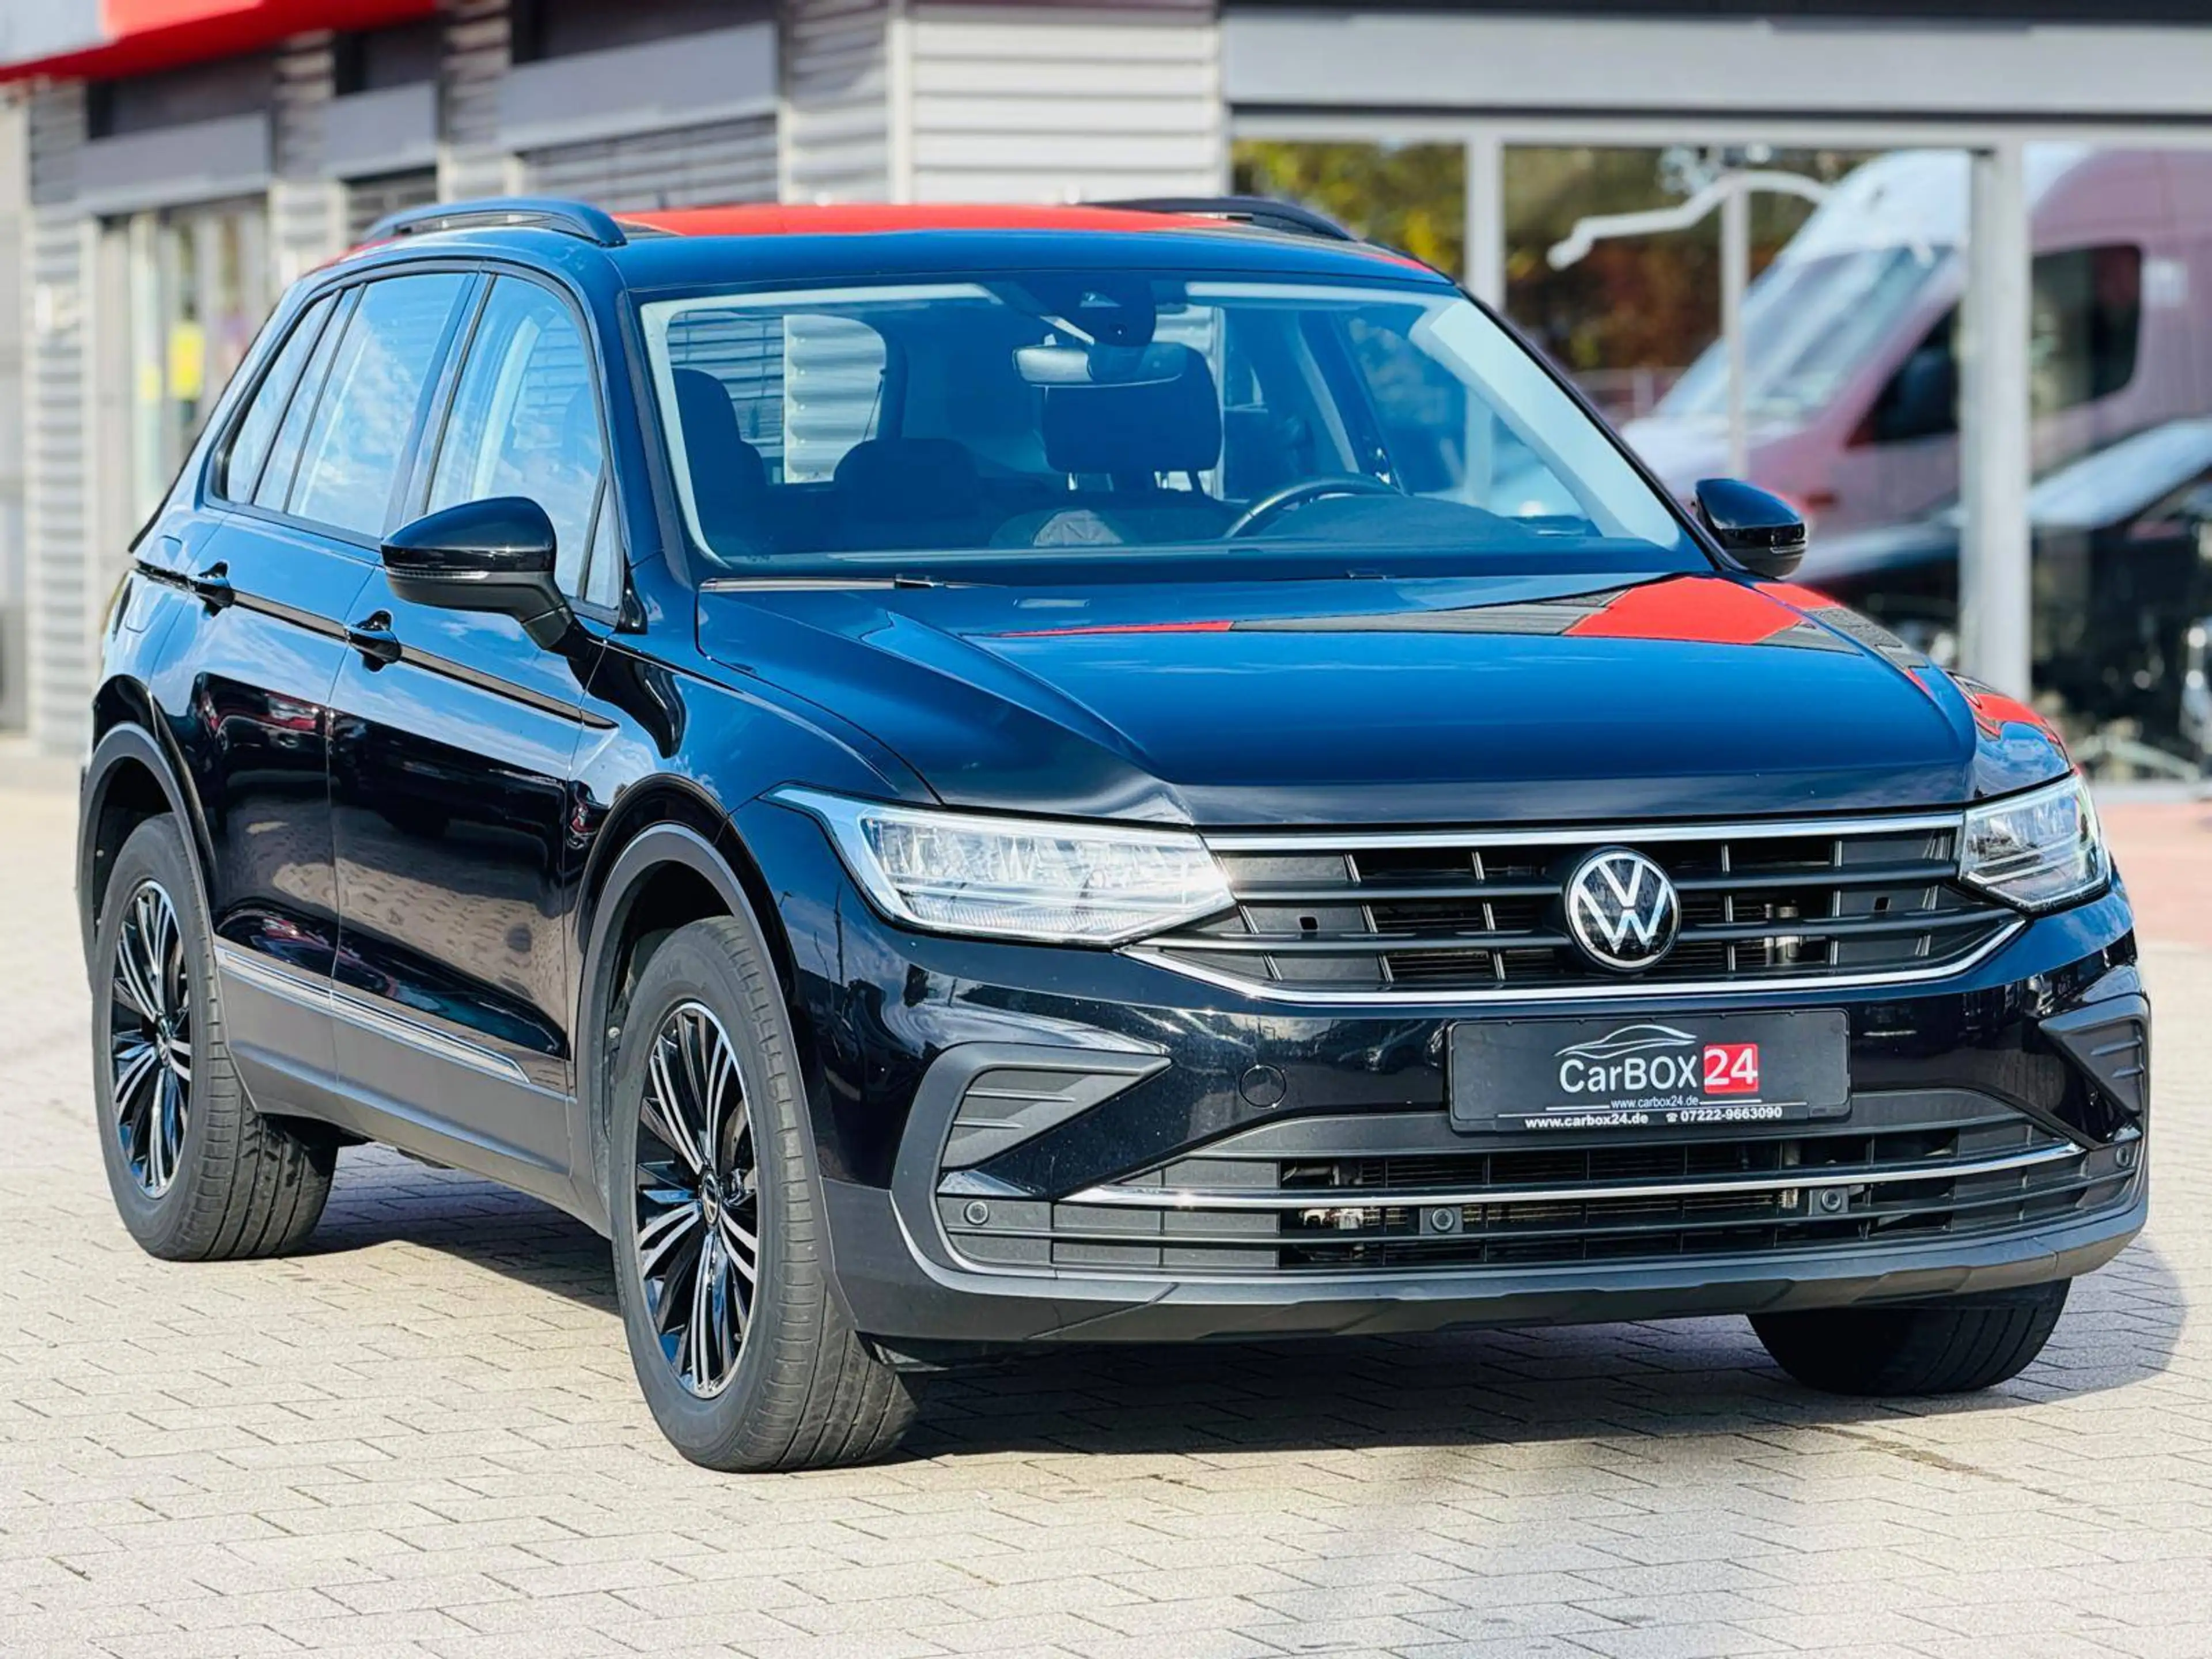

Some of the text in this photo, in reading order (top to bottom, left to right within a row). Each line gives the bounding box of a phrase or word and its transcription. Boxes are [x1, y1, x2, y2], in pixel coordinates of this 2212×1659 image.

[1610, 1096, 1699, 1108] www.carbox24.de
[1525, 1107, 1783, 1127] www.carbox24.de 07222-9663090
